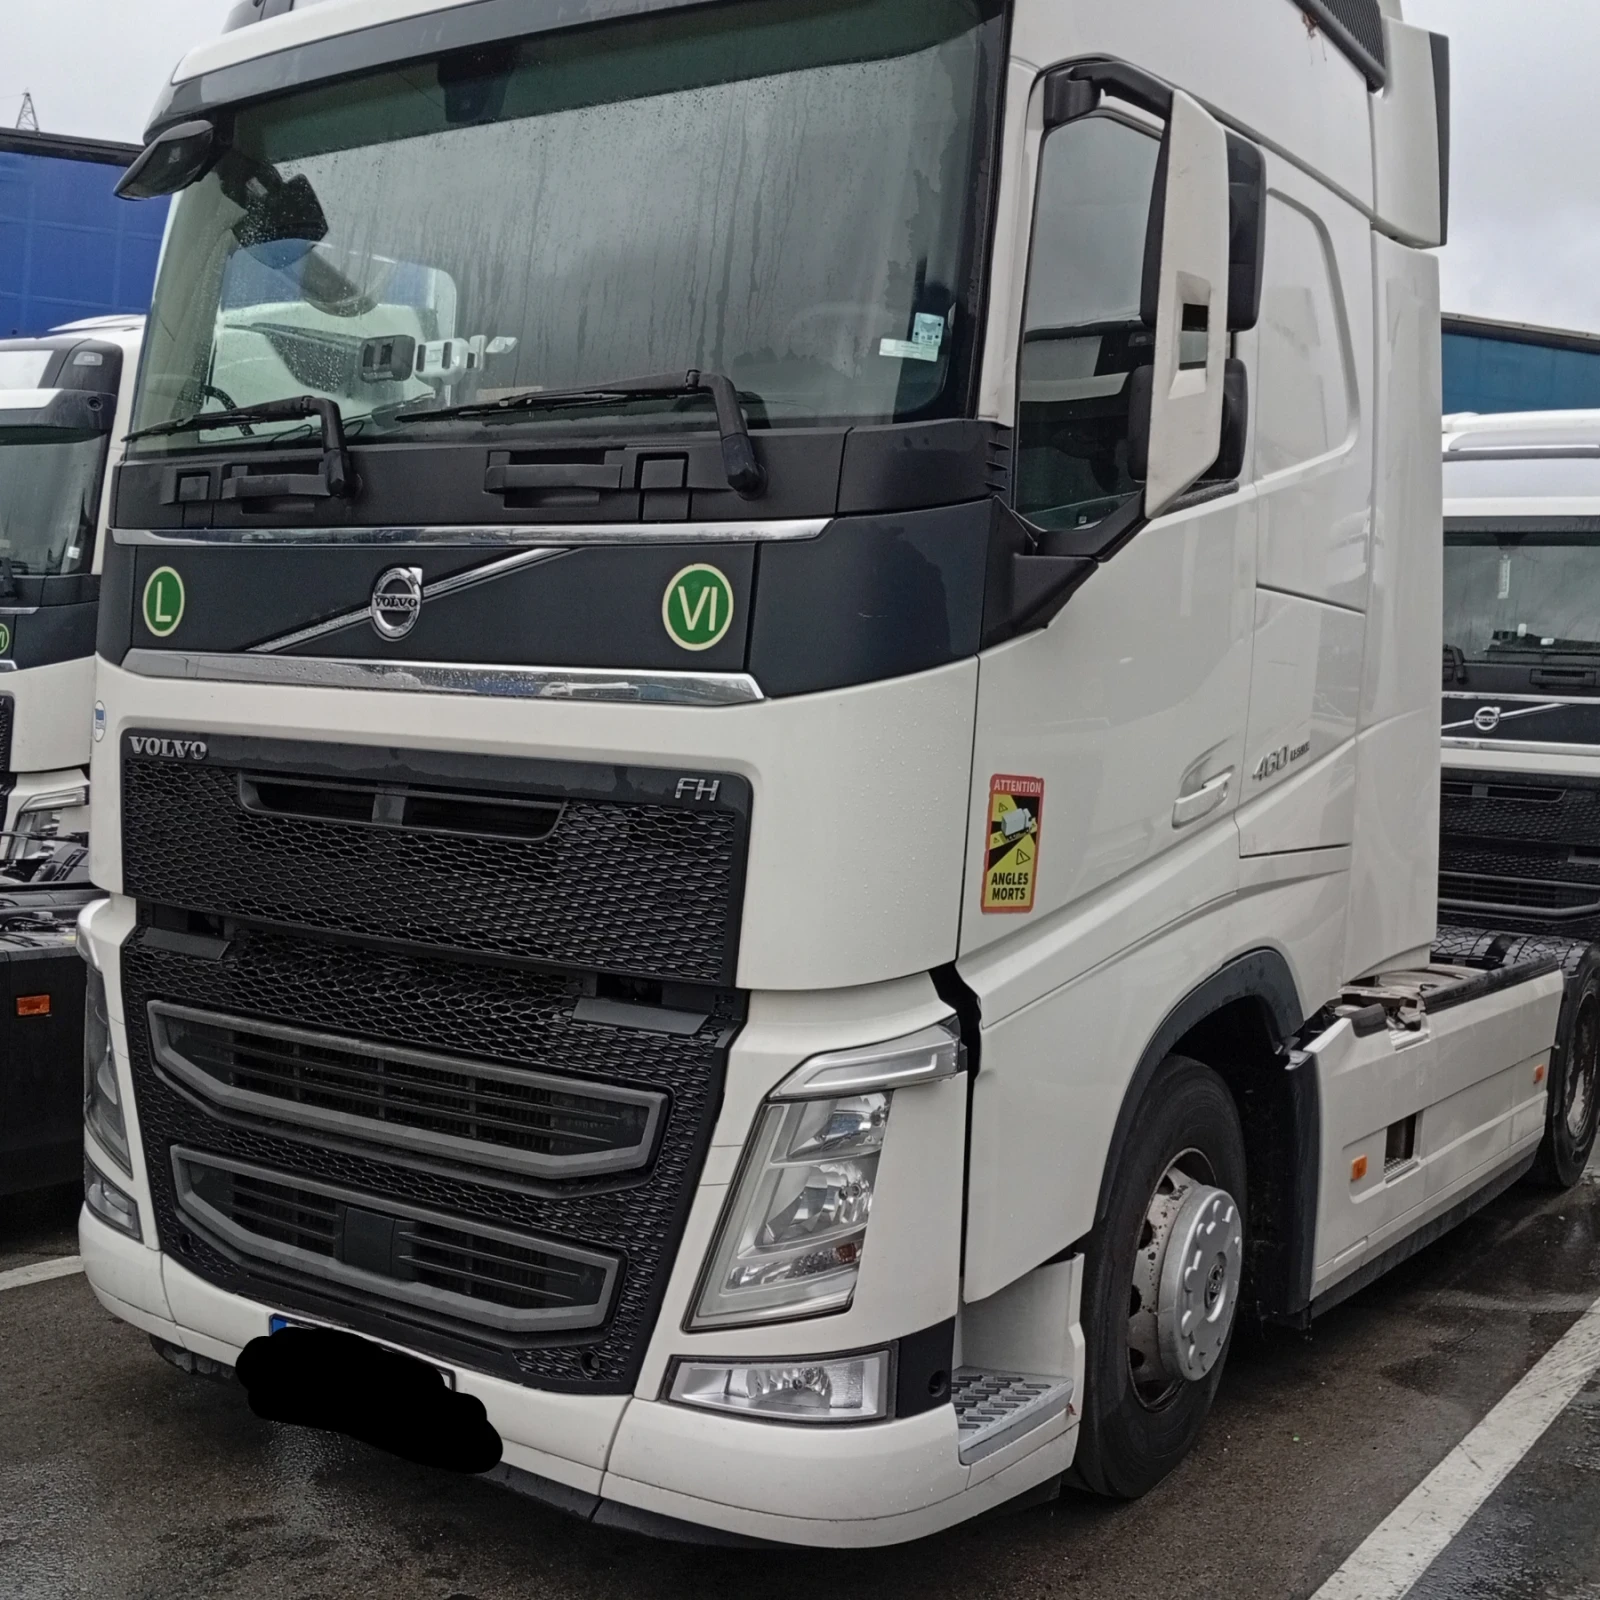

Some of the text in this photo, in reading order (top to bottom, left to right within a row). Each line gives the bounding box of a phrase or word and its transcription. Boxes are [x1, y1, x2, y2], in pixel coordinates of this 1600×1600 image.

[155, 581, 172, 622] L
[374, 596, 418, 608] VOLVO
[678, 586, 718, 631] VI
[128, 736, 208, 760] VOLVO
[1252, 744, 1289, 781] 460
[674, 777, 720, 801] FH
[993, 779, 1042, 794] ATTENTION
[991, 872, 1029, 886] ANGLES
[991, 887, 1026, 901] MORTS
